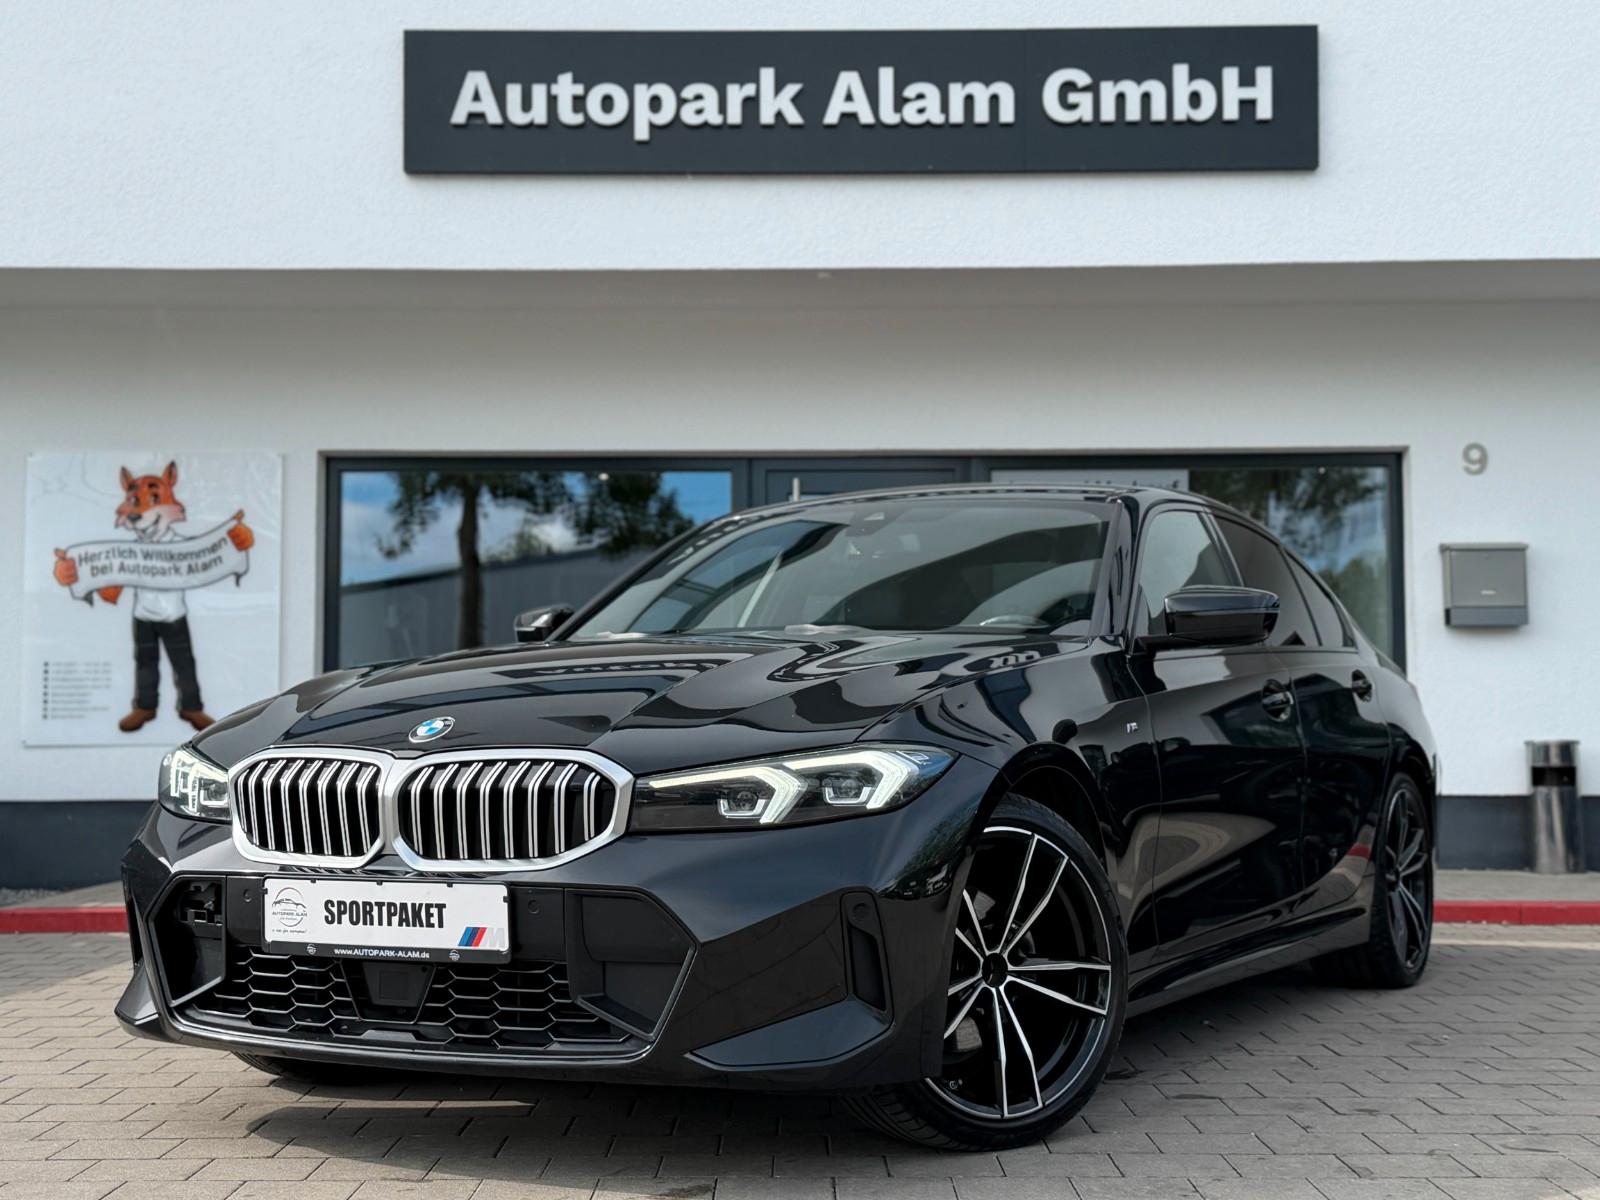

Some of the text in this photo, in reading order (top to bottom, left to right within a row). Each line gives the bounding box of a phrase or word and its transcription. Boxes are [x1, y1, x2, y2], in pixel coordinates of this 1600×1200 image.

[450, 63, 1274, 142] Autopark Alam GmbH
[1462, 442, 1489, 476] 9
[77, 537, 228, 568] Herzlich Willkommen
[118, 561, 183, 577] Autopark
[186, 555, 224, 575] Alam
[324, 899, 447, 929] SPORTPAKET
[333, 948, 430, 960] www.AUTOPARK-ALAM.de
